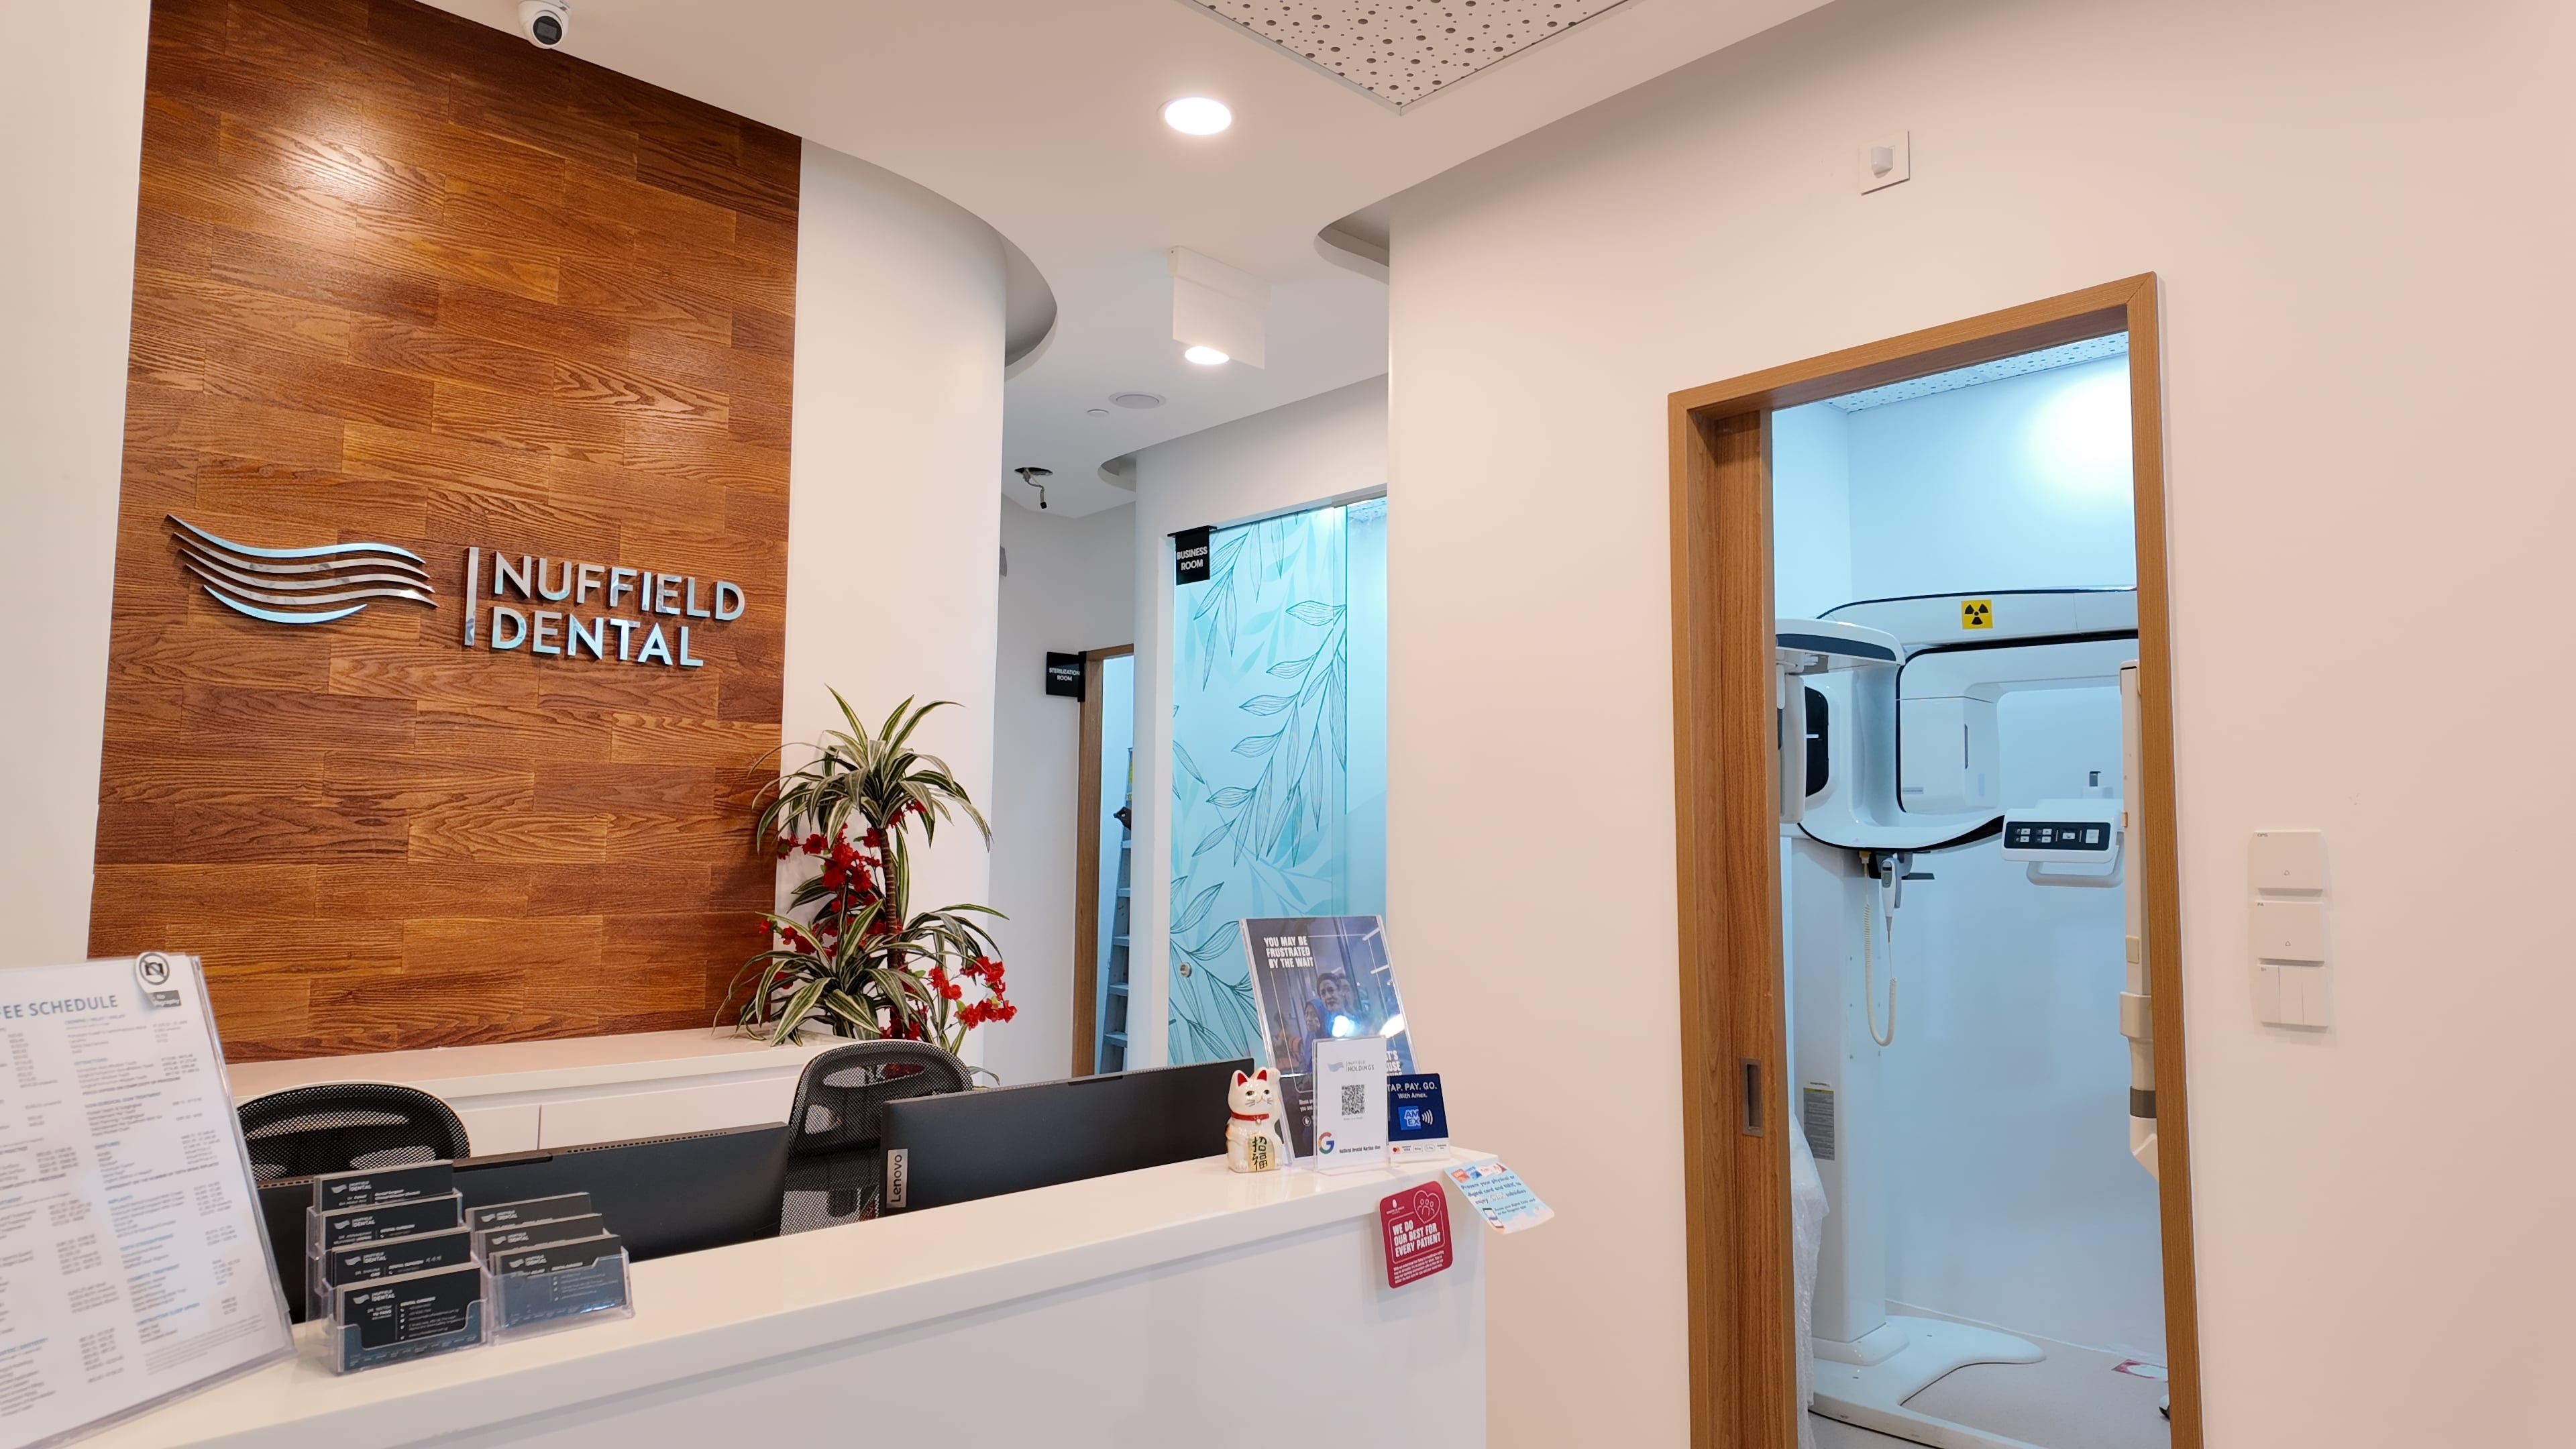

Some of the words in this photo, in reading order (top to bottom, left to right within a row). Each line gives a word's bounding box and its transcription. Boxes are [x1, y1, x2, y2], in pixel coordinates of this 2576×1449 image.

[1177, 546, 1208, 560] BUSINESS
[1181, 559, 1203, 571] ROOM
[494, 551, 745, 621] NUFFIELD
[492, 606, 704, 667] DENTAL
[1263, 936, 1279, 947] YOU
[1280, 936, 1296, 947] MAY
[1297, 936, 1308, 946] BE
[1266, 947, 1311, 958] FRUSTRATED
[1268, 958, 1278, 969] BY
[1280, 957, 1295, 968] THE
[1295, 957, 1313, 967] WAIT
[0, 1004, 23, 1019] EE
[28, 995, 118, 1016] SCHEDULE
[1387, 1083, 1403, 1092] TAP.
[1405, 1082, 1421, 1091] PAY.
[1423, 1081, 1437, 1090] GO.
[890, 1155, 902, 1203] Lenovo
[1392, 1224, 1403, 1236] WE
[1404, 1220, 1413, 1230] DO
[1394, 1234, 1407, 1246] OUR
[1409, 1227, 1424, 1239] BEST
[1426, 1222, 1437, 1235] FOR
[1395, 1242, 1415, 1257] EVERY
[1416, 1232, 1441, 1250] PATIENT
